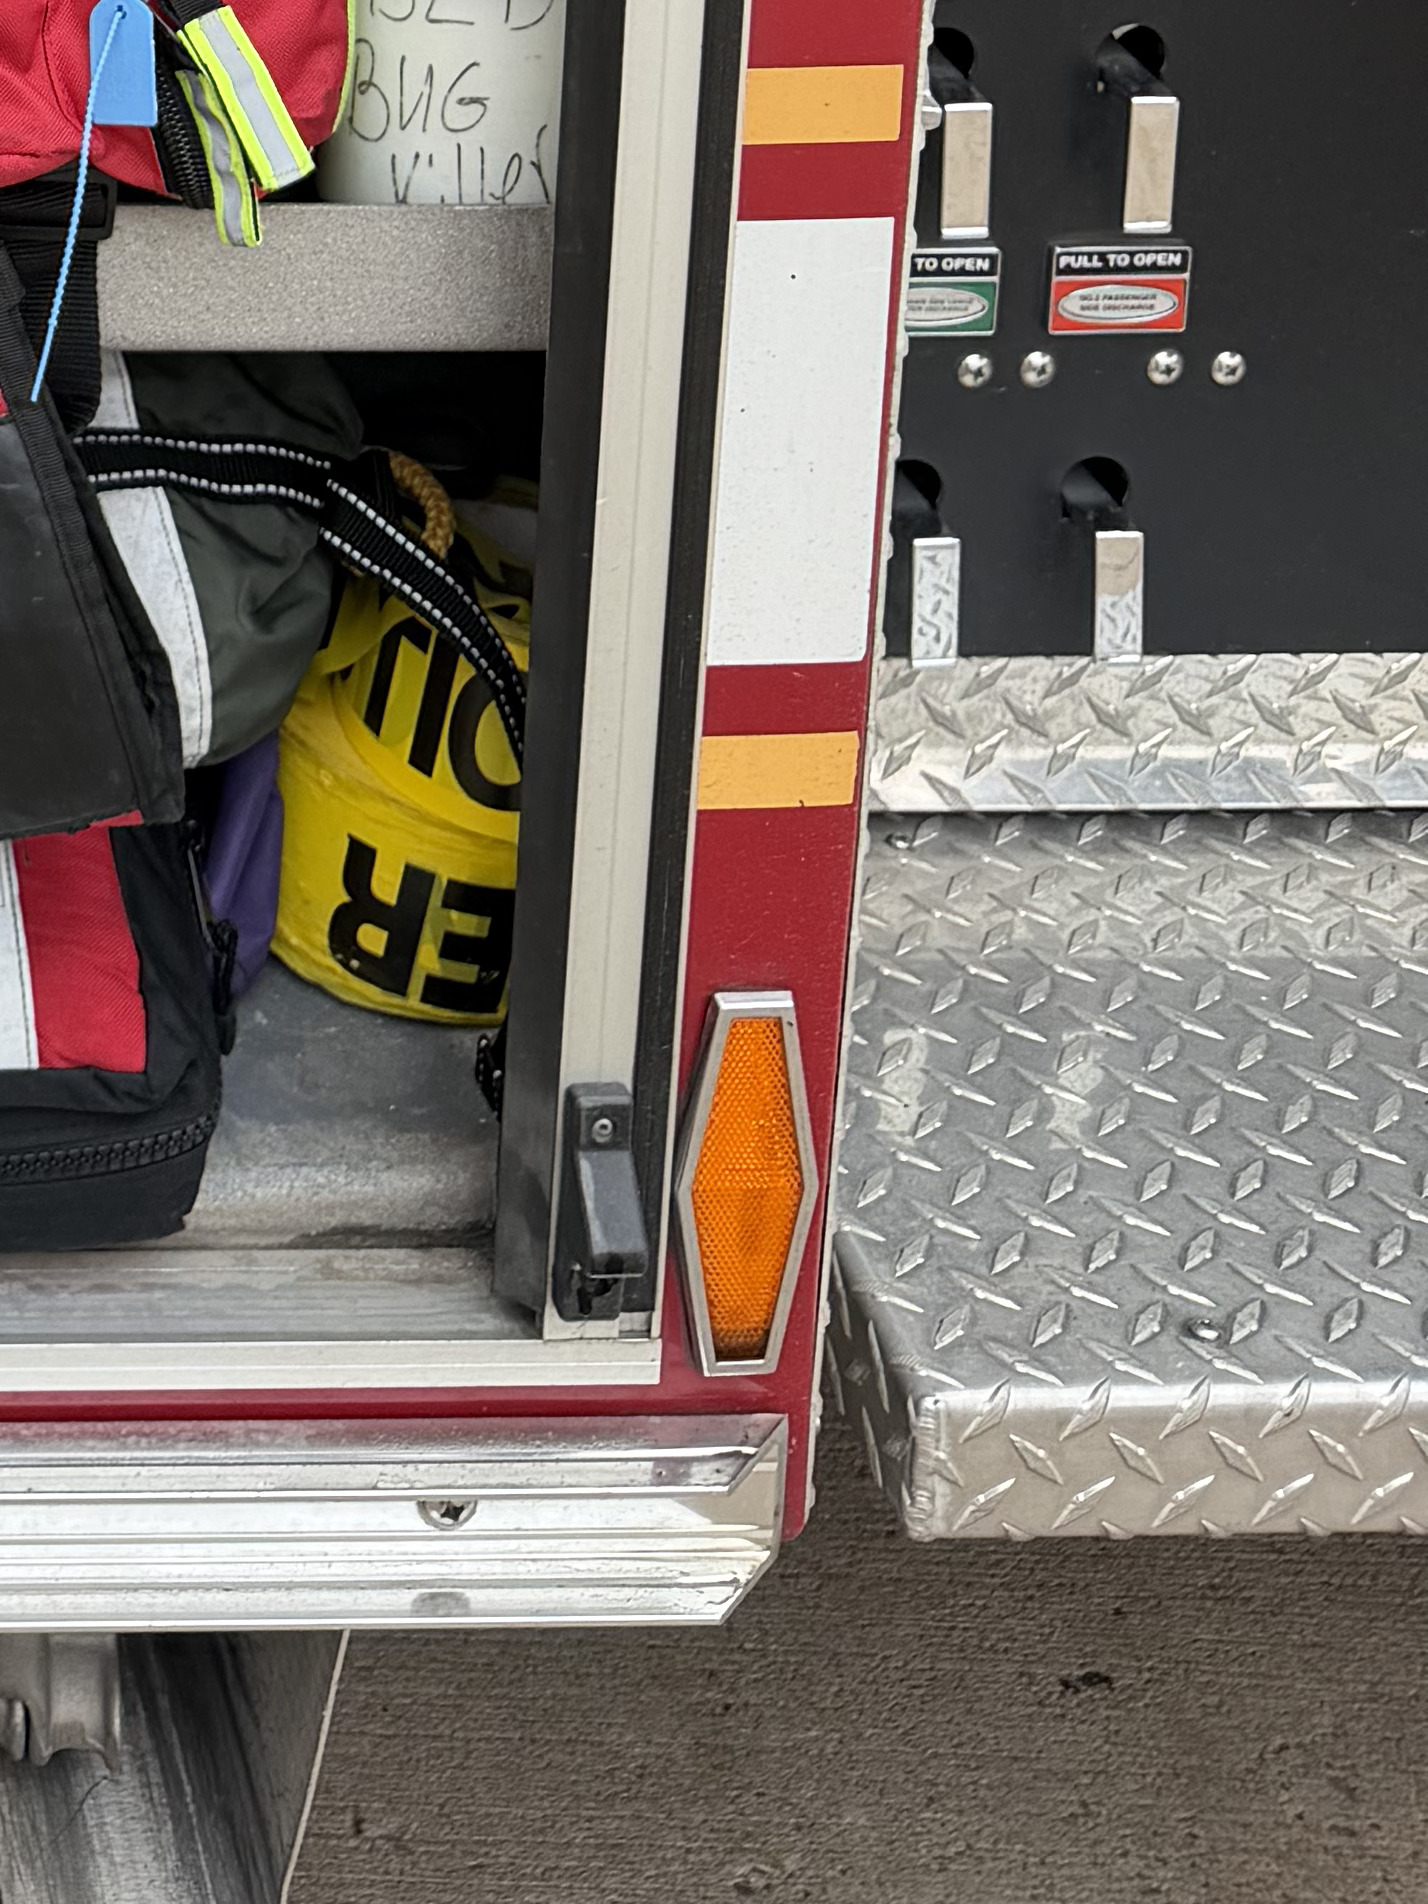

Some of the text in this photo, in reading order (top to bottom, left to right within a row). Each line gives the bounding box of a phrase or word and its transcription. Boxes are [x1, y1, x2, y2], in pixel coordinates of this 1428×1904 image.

[348, 37, 491, 143] BUG
[915, 257, 990, 271] TO OPEN
[1059, 253, 1182, 269] PULL TO OPEN
